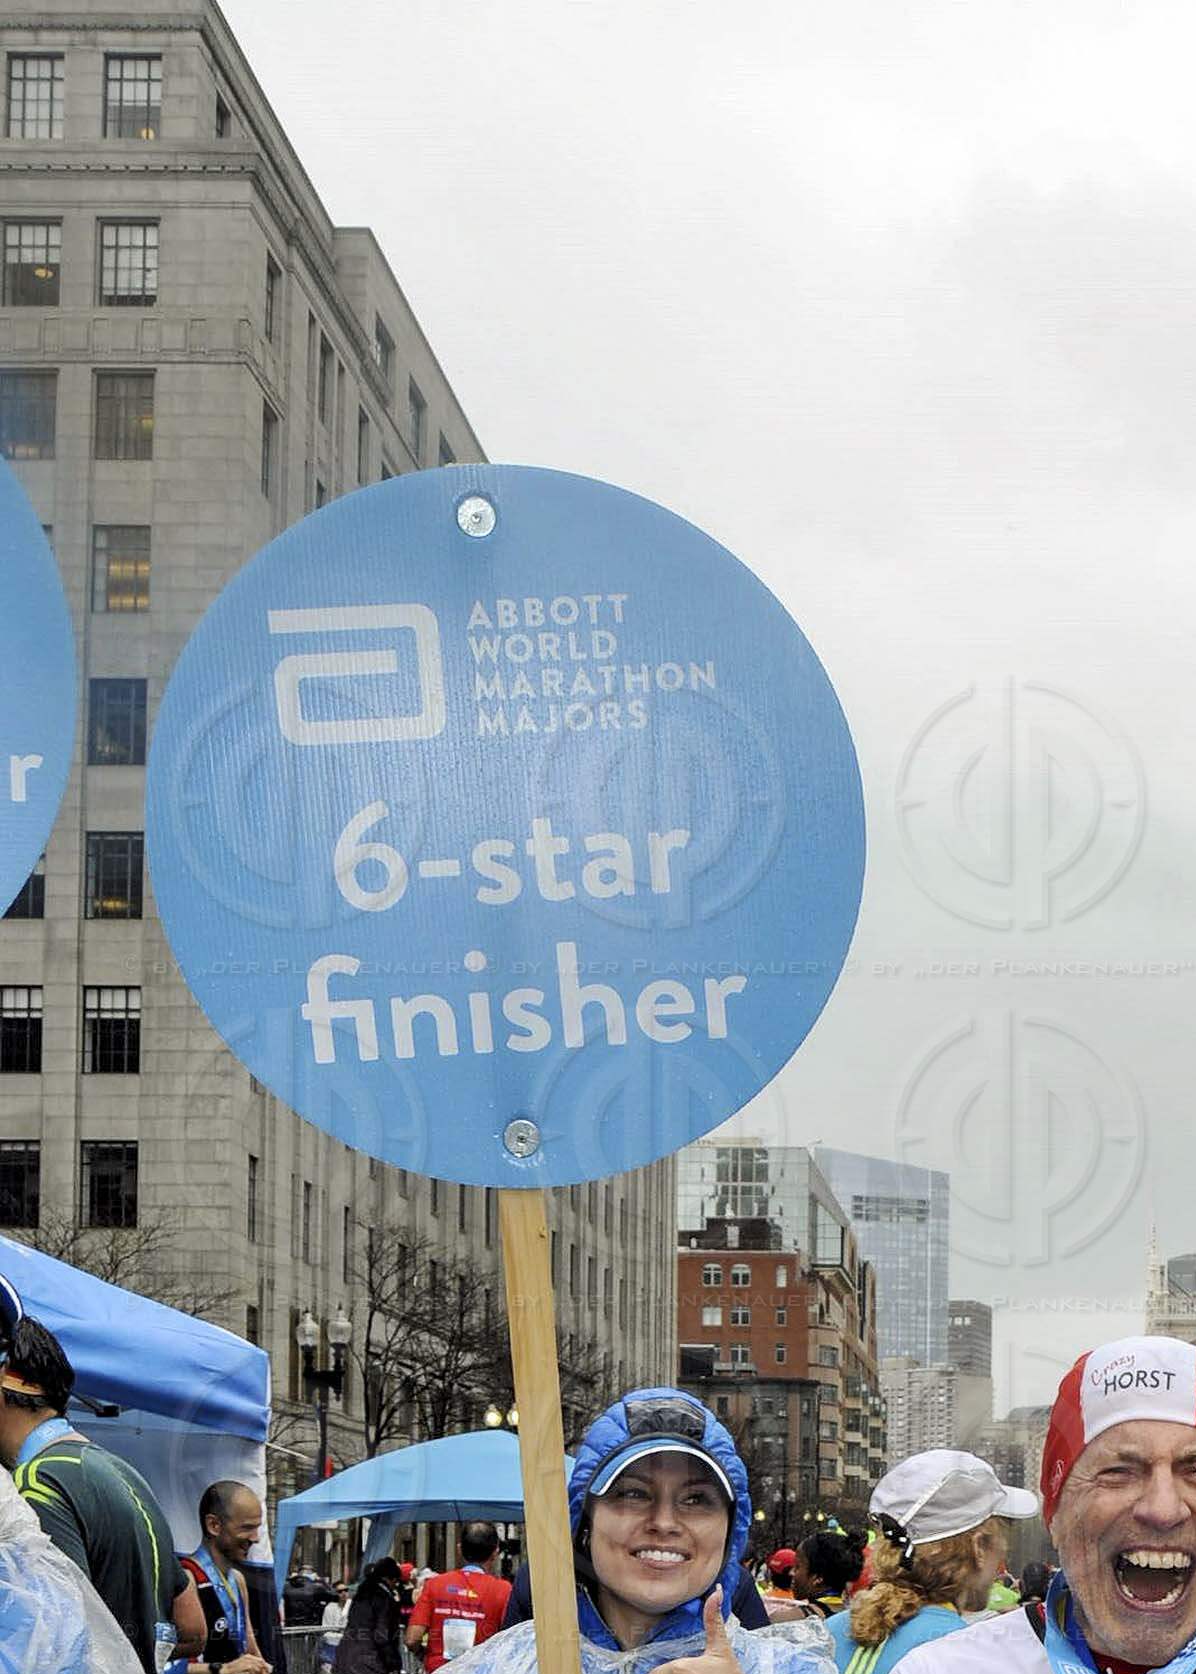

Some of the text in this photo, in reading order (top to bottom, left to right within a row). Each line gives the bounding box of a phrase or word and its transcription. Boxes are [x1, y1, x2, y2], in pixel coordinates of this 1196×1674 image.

[467, 594, 628, 631] ABBOTT
[468, 630, 618, 665] WORLD
[475, 661, 717, 700] MARATHON
[478, 698, 649, 737] MAJORS
[333, 799, 690, 912] 6-star
[302, 941, 746, 1064] finisher
[1104, 1370, 1176, 1395] HORST
